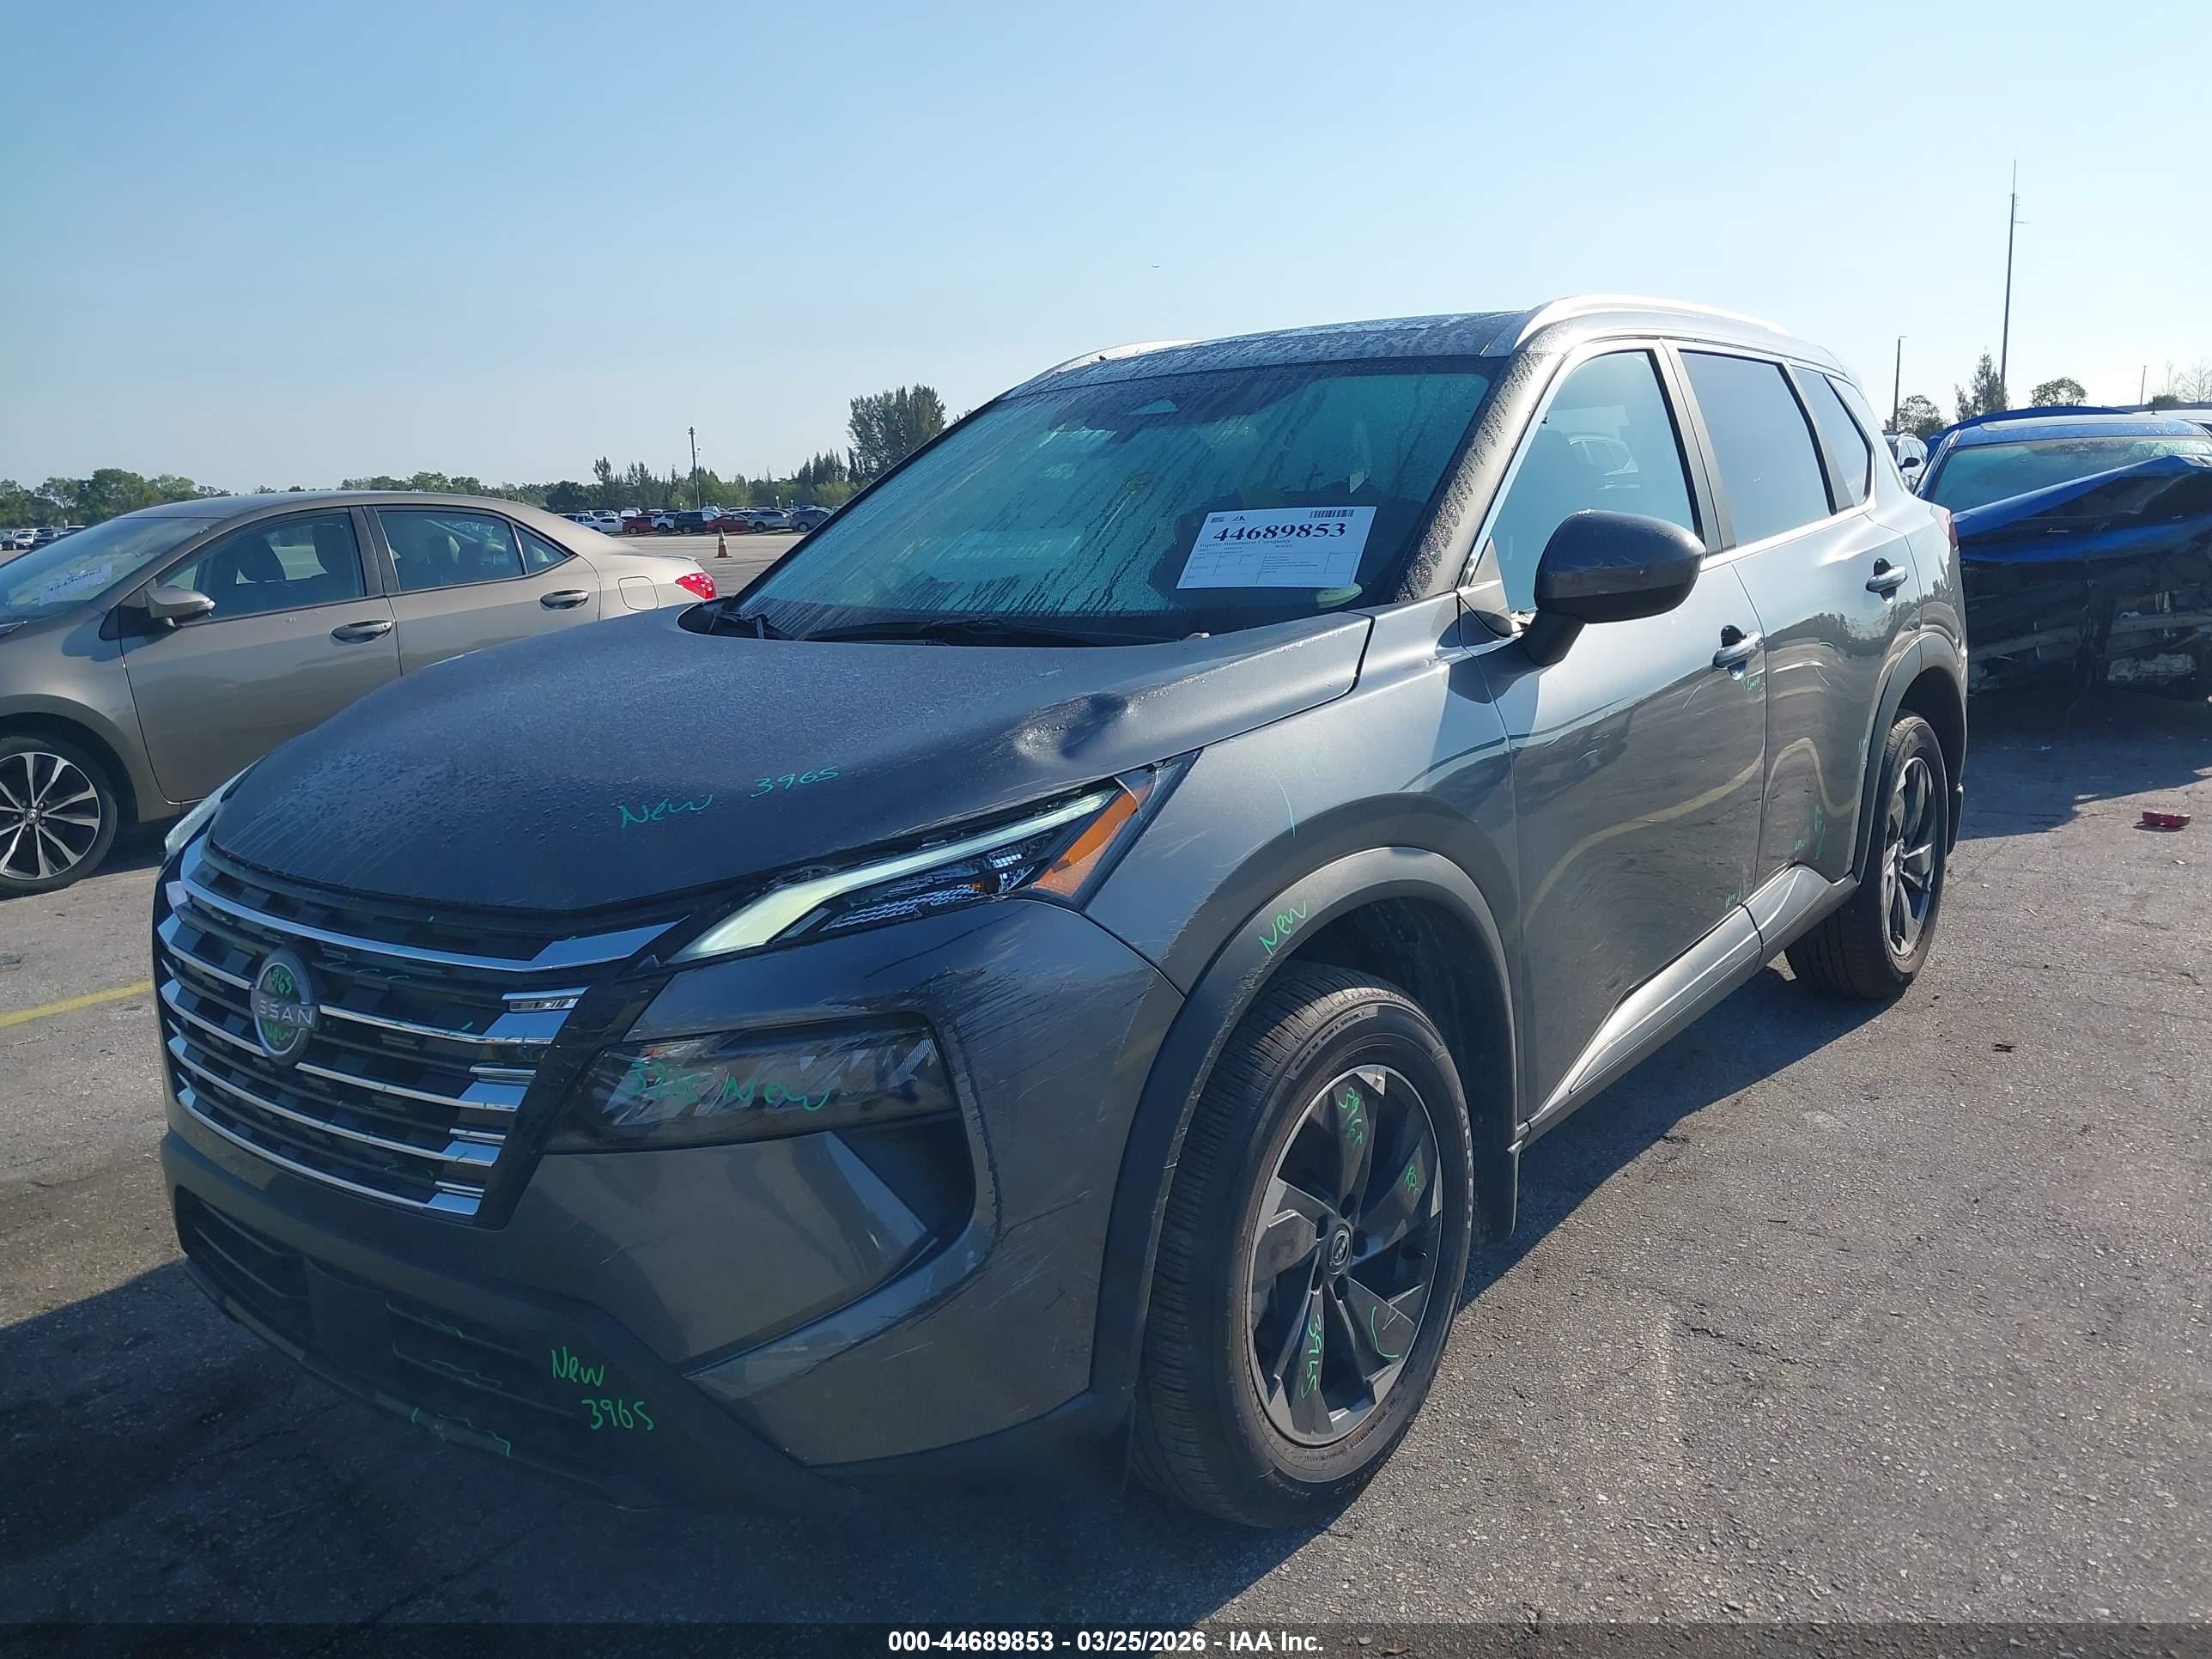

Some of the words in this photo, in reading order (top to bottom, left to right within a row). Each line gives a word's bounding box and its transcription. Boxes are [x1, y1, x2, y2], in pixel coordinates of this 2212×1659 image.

[1212, 522, 1346, 542] 44689853
[617, 794, 714, 829] New
[750, 766, 839, 798] 3965
[1259, 900, 1307, 956] New
[551, 1346, 605, 1388] New
[1300, 1314, 1322, 1399] 3965
[581, 1399, 653, 1431] 3965
